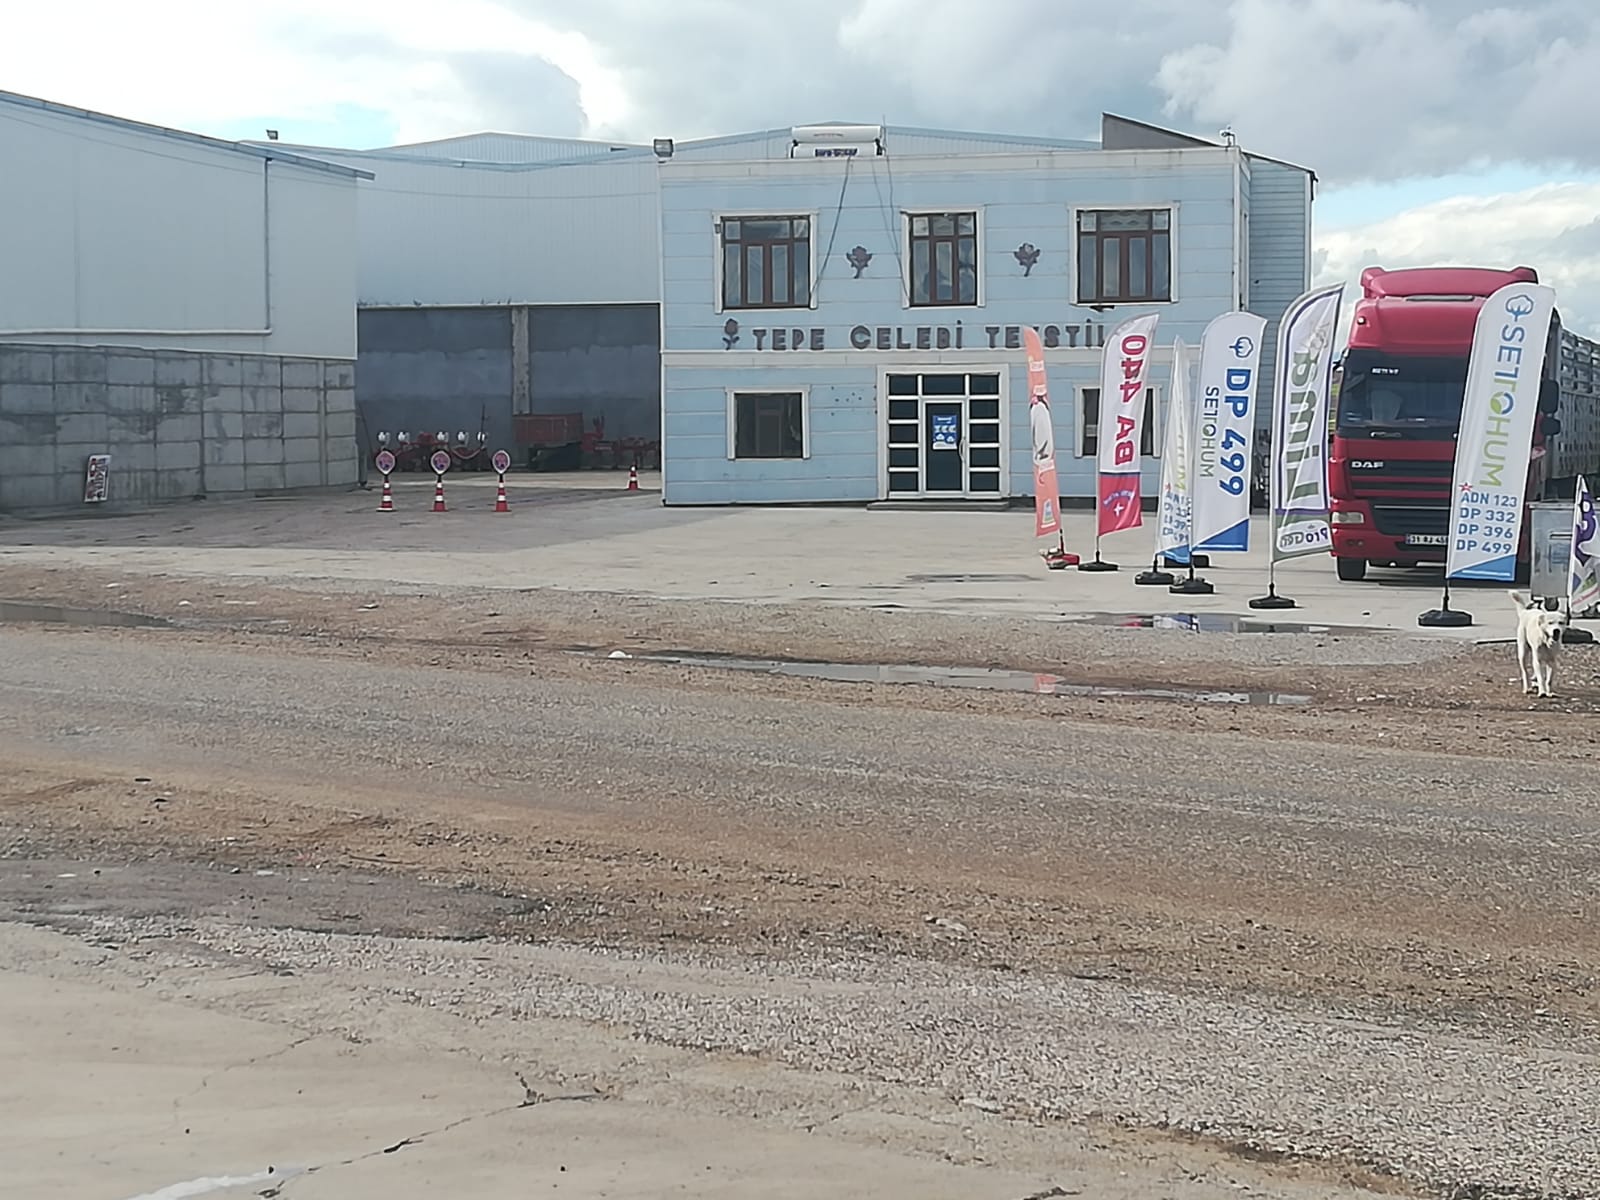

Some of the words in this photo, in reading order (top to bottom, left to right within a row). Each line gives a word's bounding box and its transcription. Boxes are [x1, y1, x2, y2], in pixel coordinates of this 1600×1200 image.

[752, 328, 825, 350] TEPE
[985, 318, 1105, 349] TESTİL
[1224, 368, 1252, 418] DP
[1219, 428, 1247, 496] 499
[1351, 461, 1384, 469] DAF
[1460, 491, 1490, 504] ADN
[1494, 494, 1518, 508] 123
[1459, 507, 1481, 519] DP
[1485, 510, 1516, 524] 332
[1458, 523, 1480, 535] DP
[1483, 525, 1514, 539] 396
[1456, 539, 1478, 552] DP
[1481, 541, 1513, 555] 499
